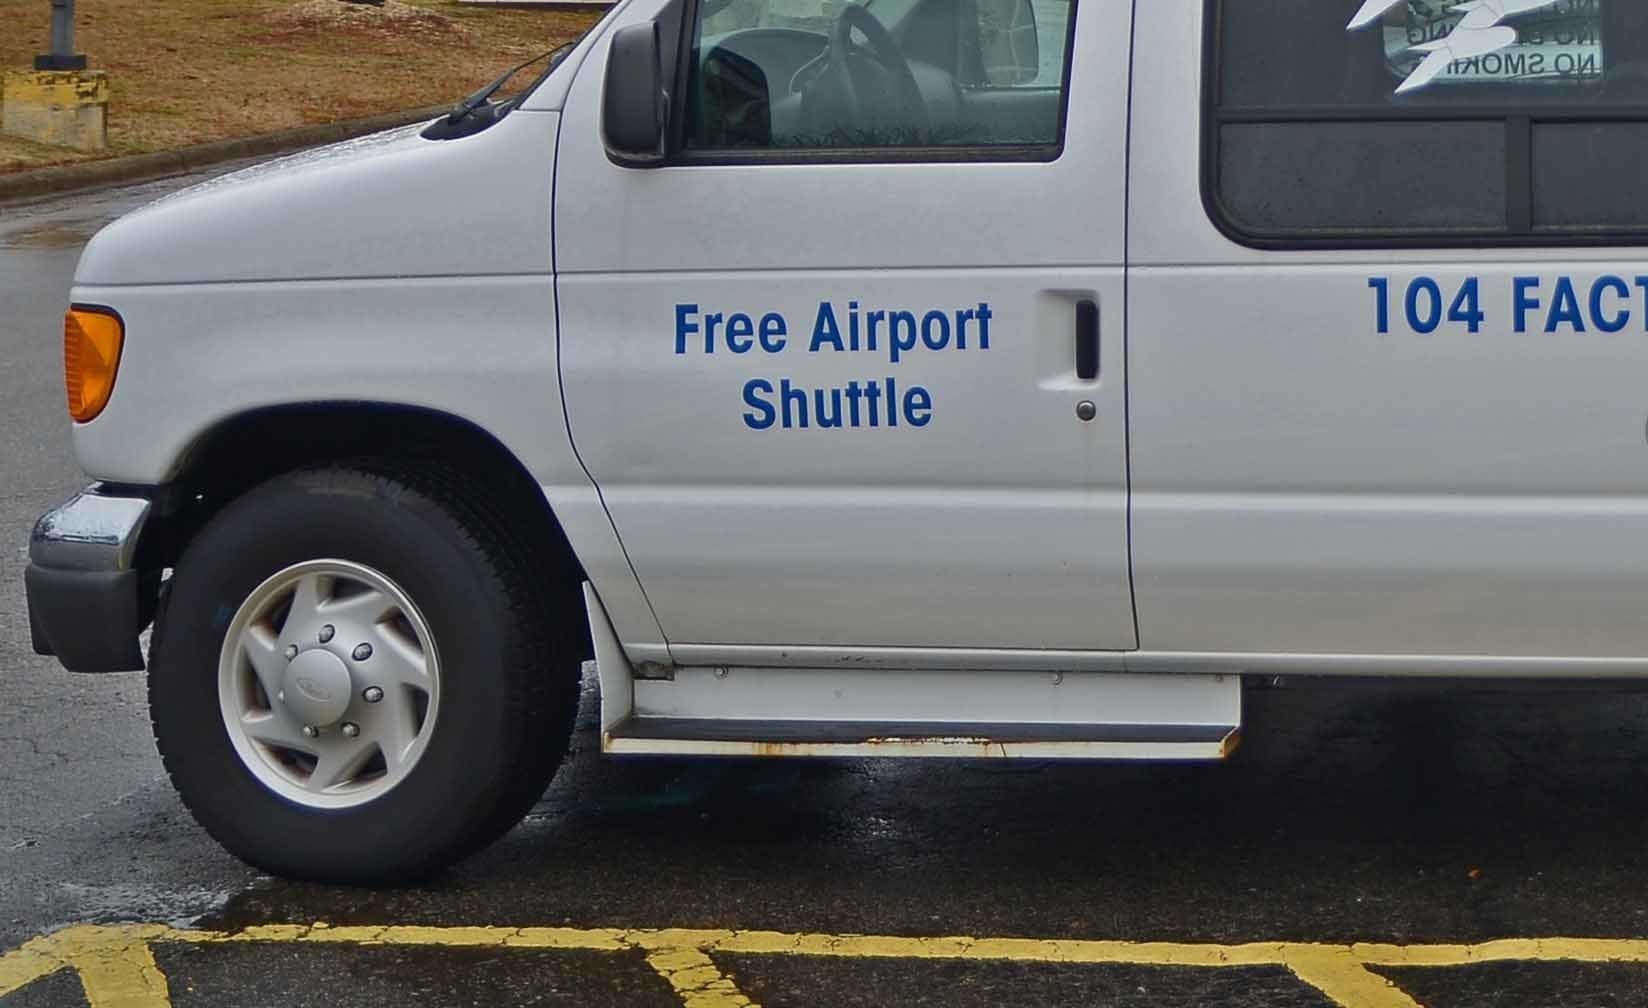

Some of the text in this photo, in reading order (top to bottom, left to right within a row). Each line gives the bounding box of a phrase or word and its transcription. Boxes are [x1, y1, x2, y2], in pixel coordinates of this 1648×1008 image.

[674, 301, 993, 364] Free Airport
[1368, 275, 1485, 334] 104
[742, 377, 933, 431] Shuttle
